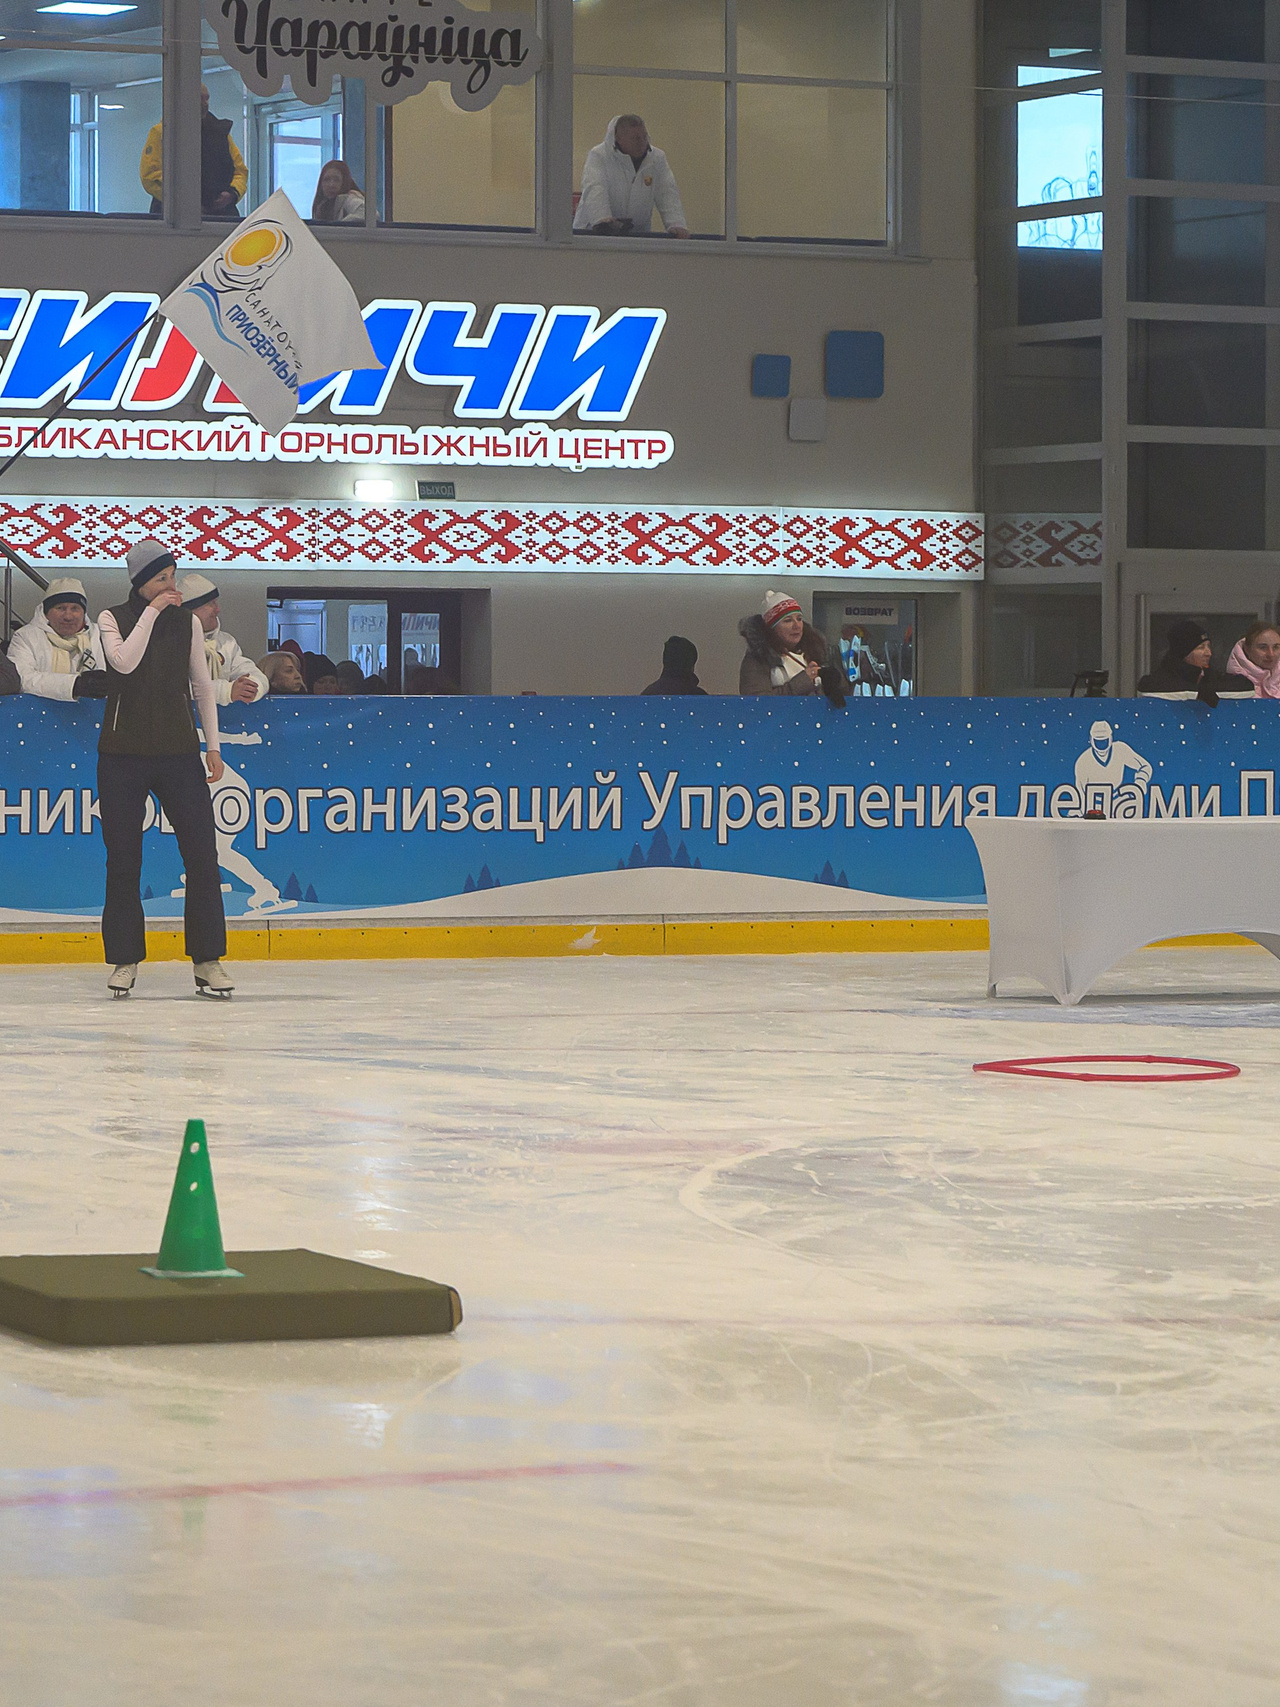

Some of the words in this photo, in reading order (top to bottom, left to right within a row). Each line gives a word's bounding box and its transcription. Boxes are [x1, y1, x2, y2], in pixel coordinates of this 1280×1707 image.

[260, 430, 548, 458] ГОРНОЛЫЖНЫЙ
[558, 438, 666, 463] ЦЕНТР
[419, 485, 455, 498] ВЫХОД
[845, 606, 894, 617] ВОЗВРАТ
[211, 769, 623, 850] организаций
[637, 770, 997, 845] Управления
